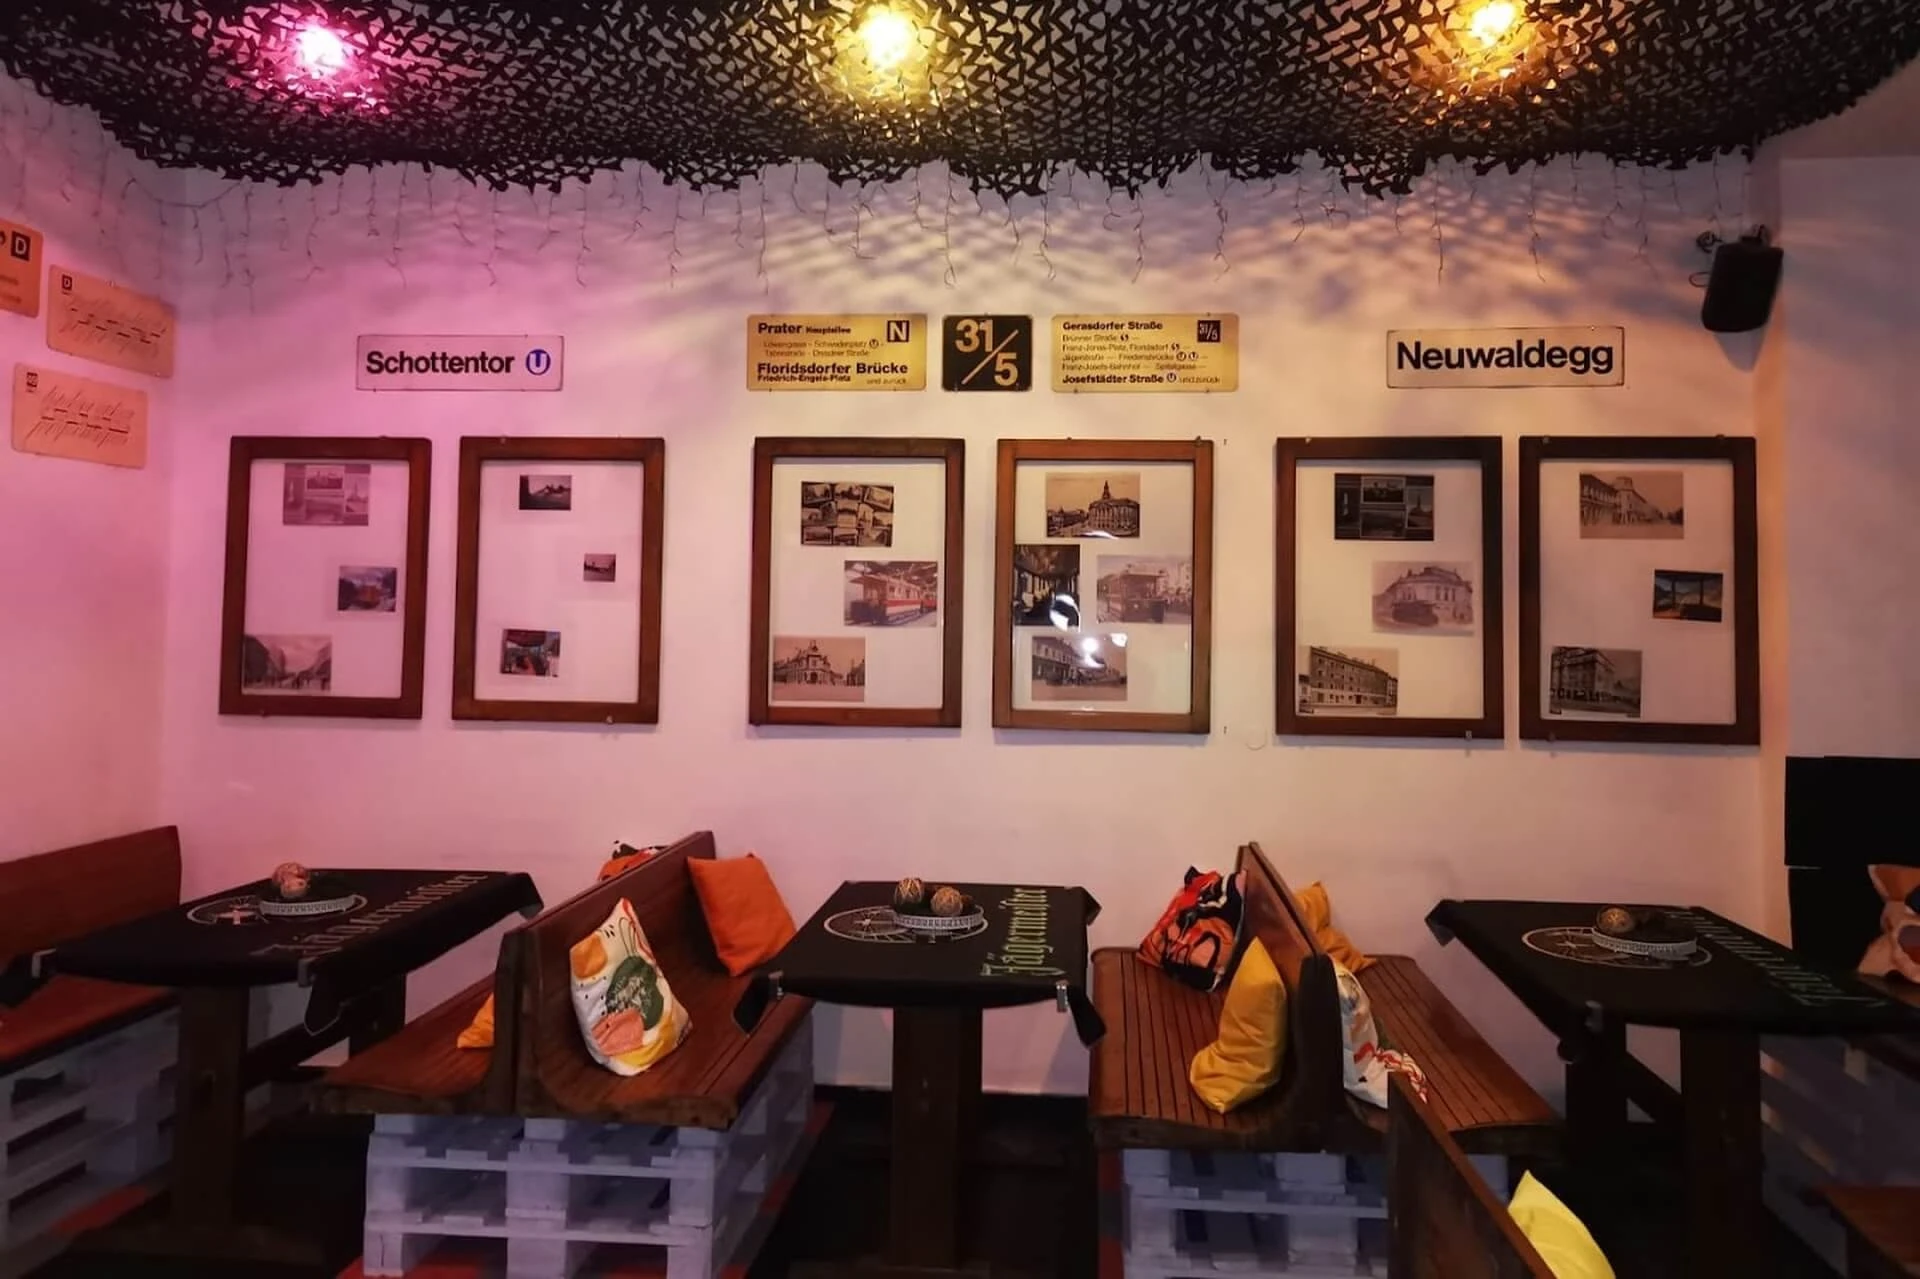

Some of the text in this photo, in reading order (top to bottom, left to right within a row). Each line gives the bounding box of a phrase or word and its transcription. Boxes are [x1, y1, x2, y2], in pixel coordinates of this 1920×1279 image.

[14, 235, 28, 257] D
[757, 322, 852, 335] Prater Hauptallee
[889, 321, 908, 341] N
[1063, 321, 1164, 330] Gerasdorfer Straße
[1094, 334, 1117, 342] Straße
[366, 351, 515, 374] Schottentor
[1397, 339, 1613, 375] Neuwaldegg
[757, 362, 908, 374] Floridsdorfer Brücke
[757, 374, 851, 384] Friedrich-Engels-Platz
[1062, 374, 1127, 384] Josefstädter
[1129, 374, 1165, 384] Straße
